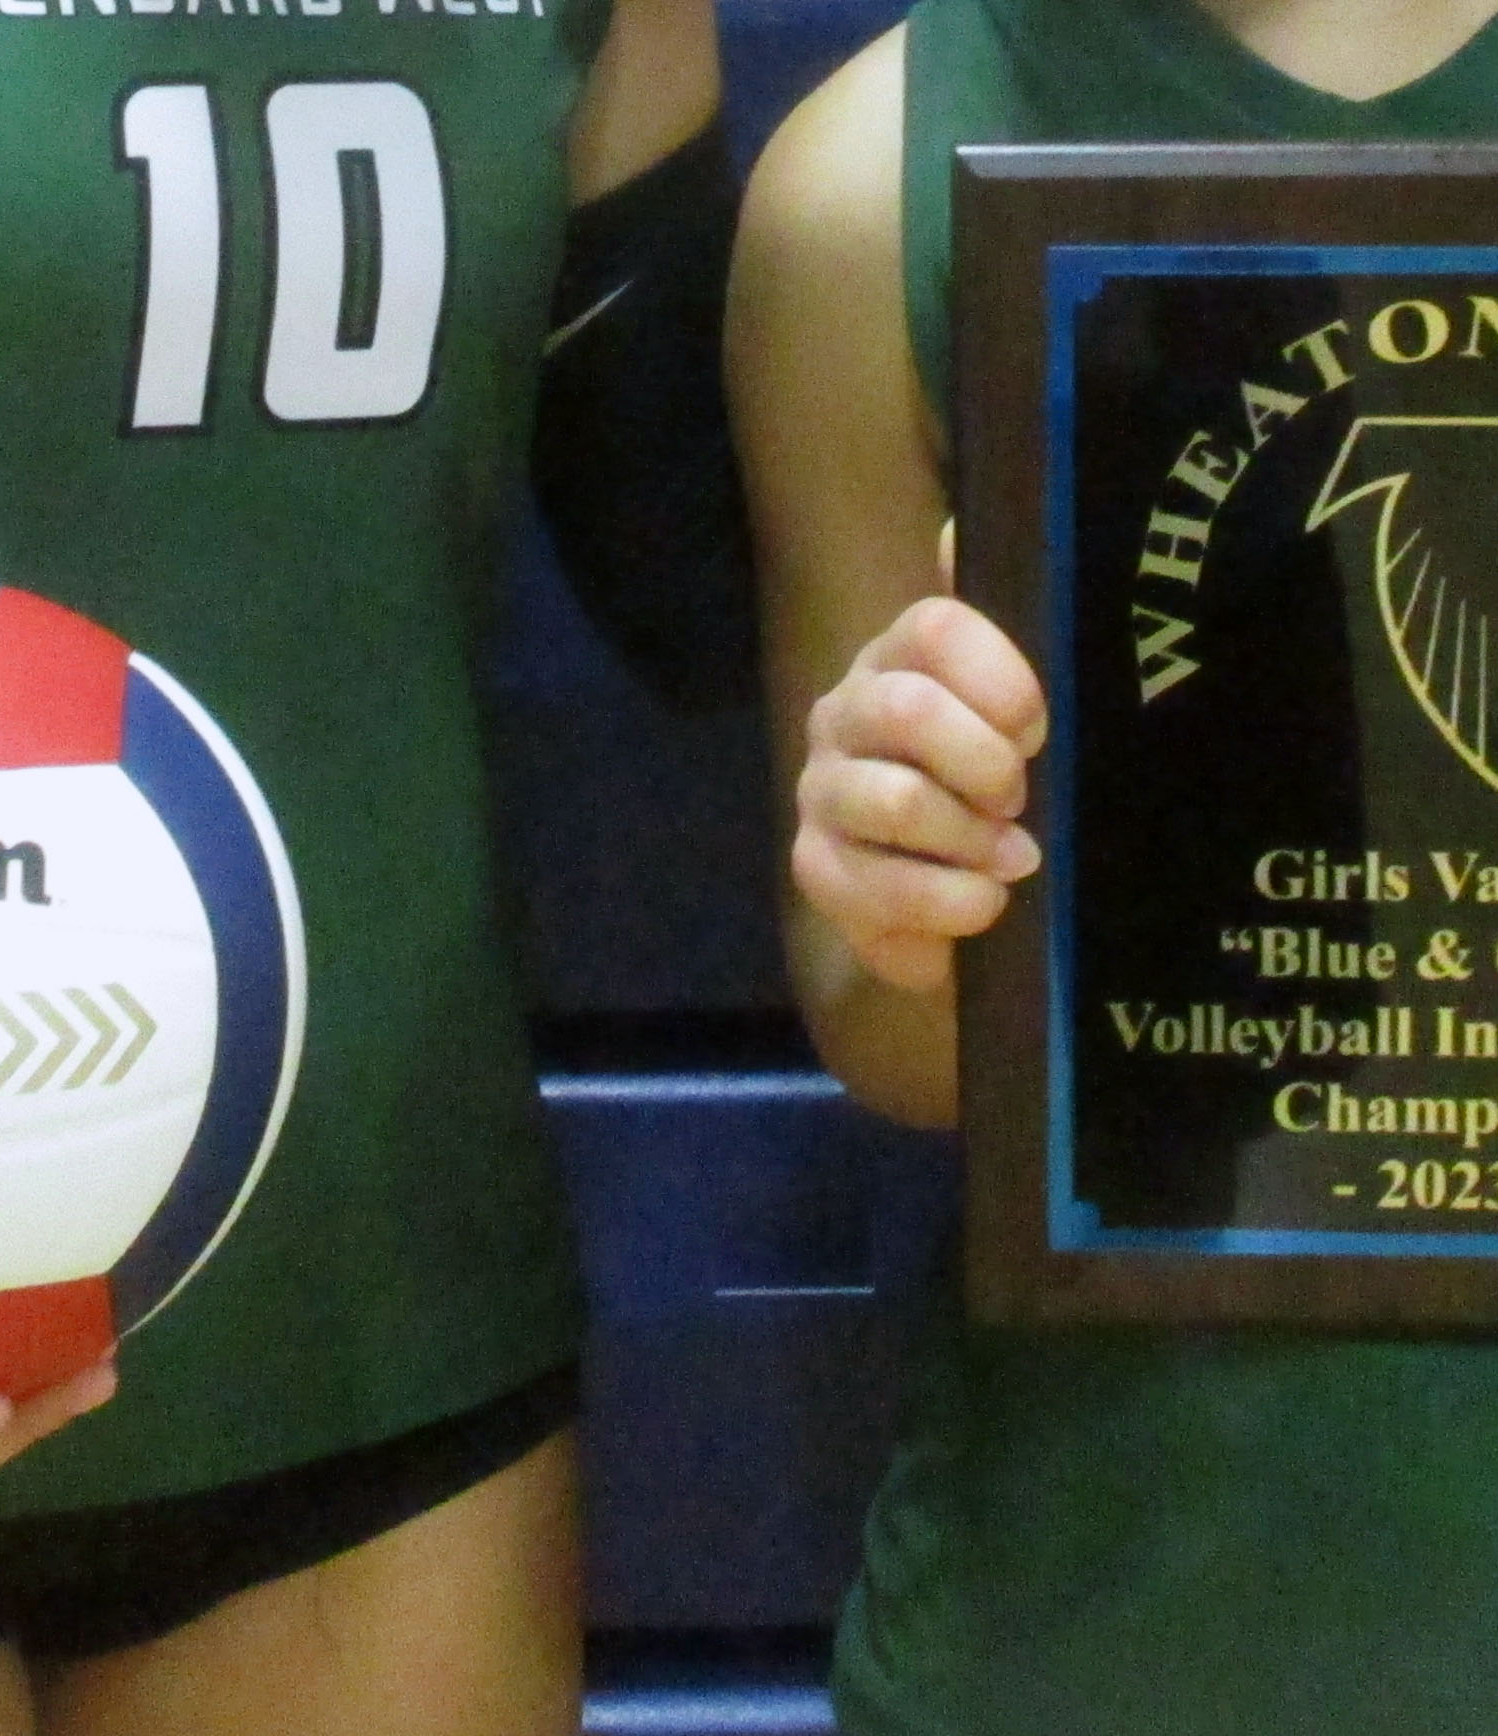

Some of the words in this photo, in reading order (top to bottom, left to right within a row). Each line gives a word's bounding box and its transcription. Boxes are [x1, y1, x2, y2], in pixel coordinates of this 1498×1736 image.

[122, 81, 447, 429] 10
[1252, 850, 1410, 903] Girls
[1218, 926, 1397, 981] “Blue
[1416, 928, 1475, 982] &
[1105, 1001, 1412, 1069] Volleyball
